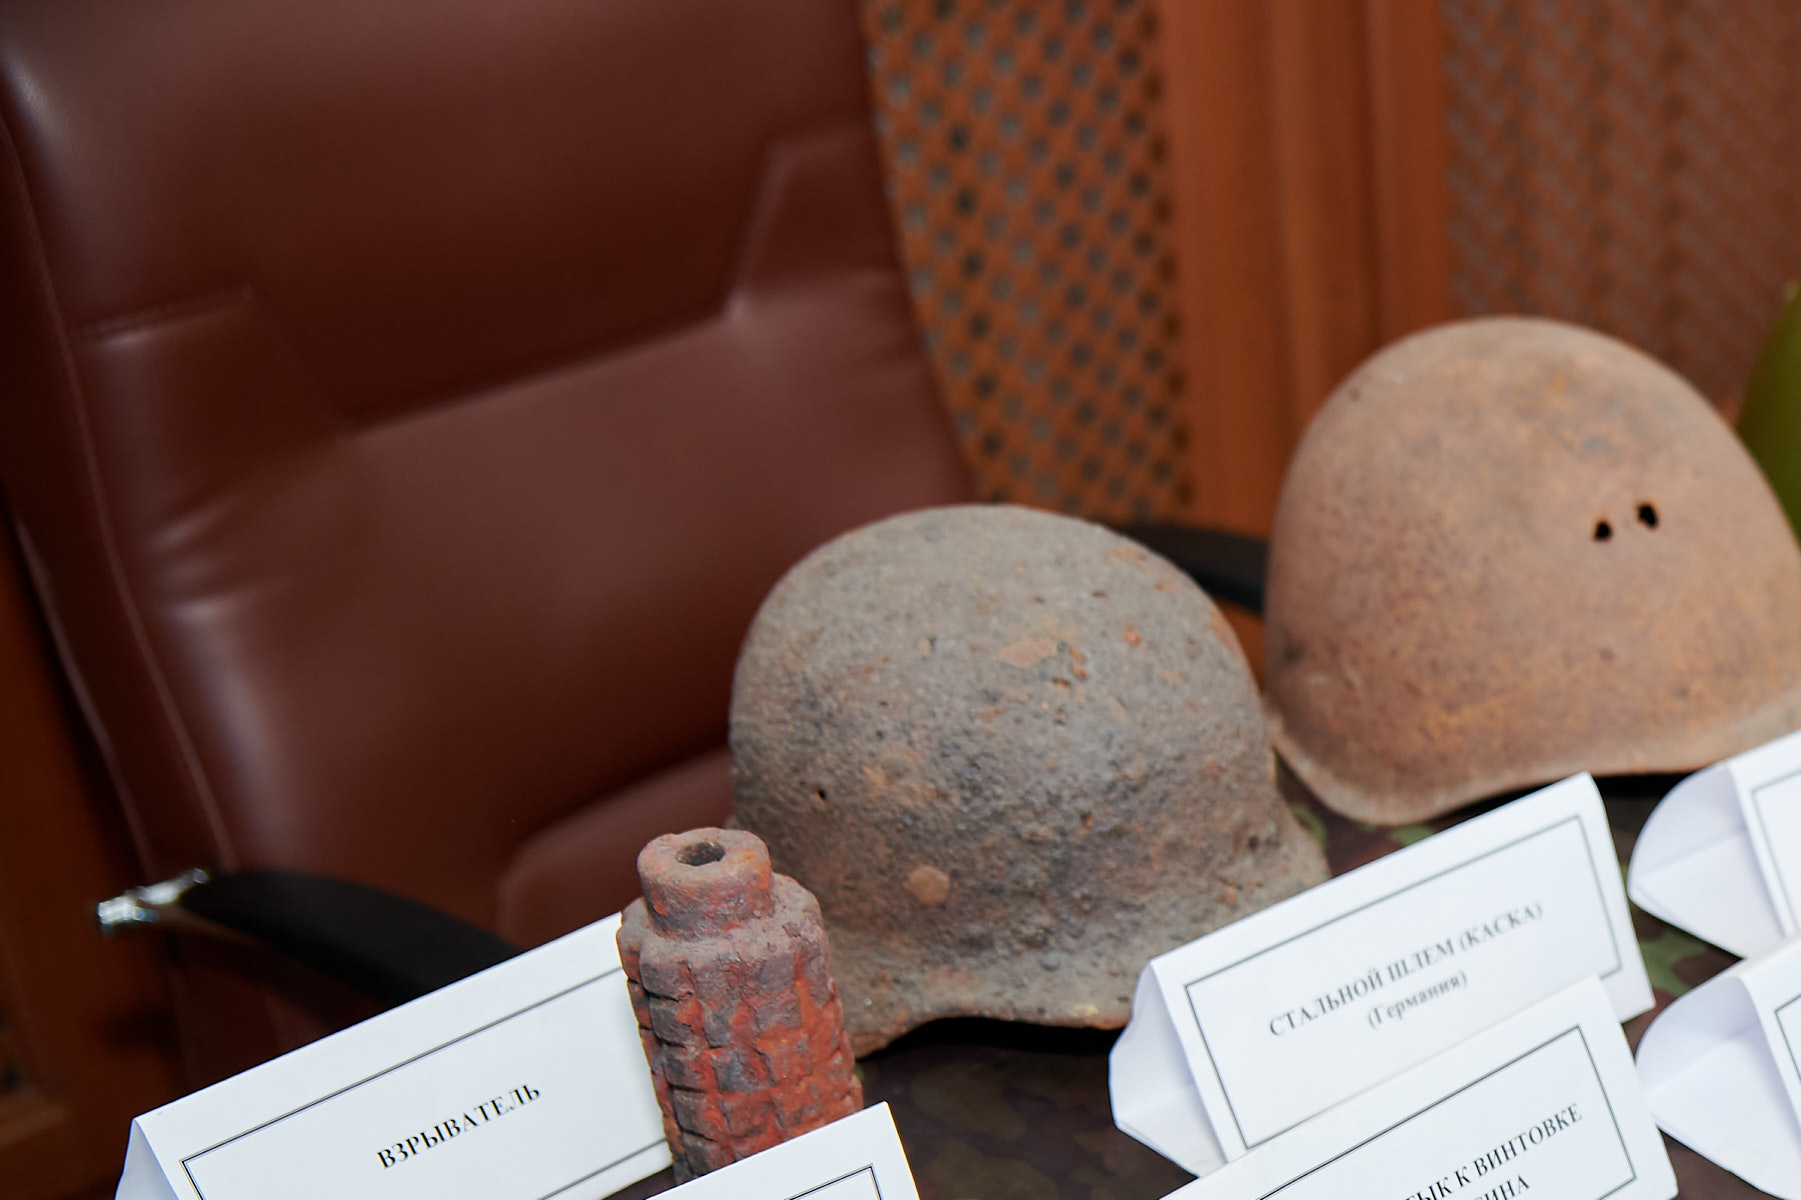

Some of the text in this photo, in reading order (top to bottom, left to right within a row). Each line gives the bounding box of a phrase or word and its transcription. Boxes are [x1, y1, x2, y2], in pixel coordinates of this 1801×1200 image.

[1269, 902, 1542, 1036] СТАЛЬНОЙ ШЛЕМ (КАСКА)
[1368, 970, 1468, 1030] (Германия)
[378, 1083, 542, 1171] ВЗРЫВАТЕЛЬ
[1455, 1166, 1473, 1188] К
[1473, 1103, 1583, 1178] ВИНТОВКЕ
